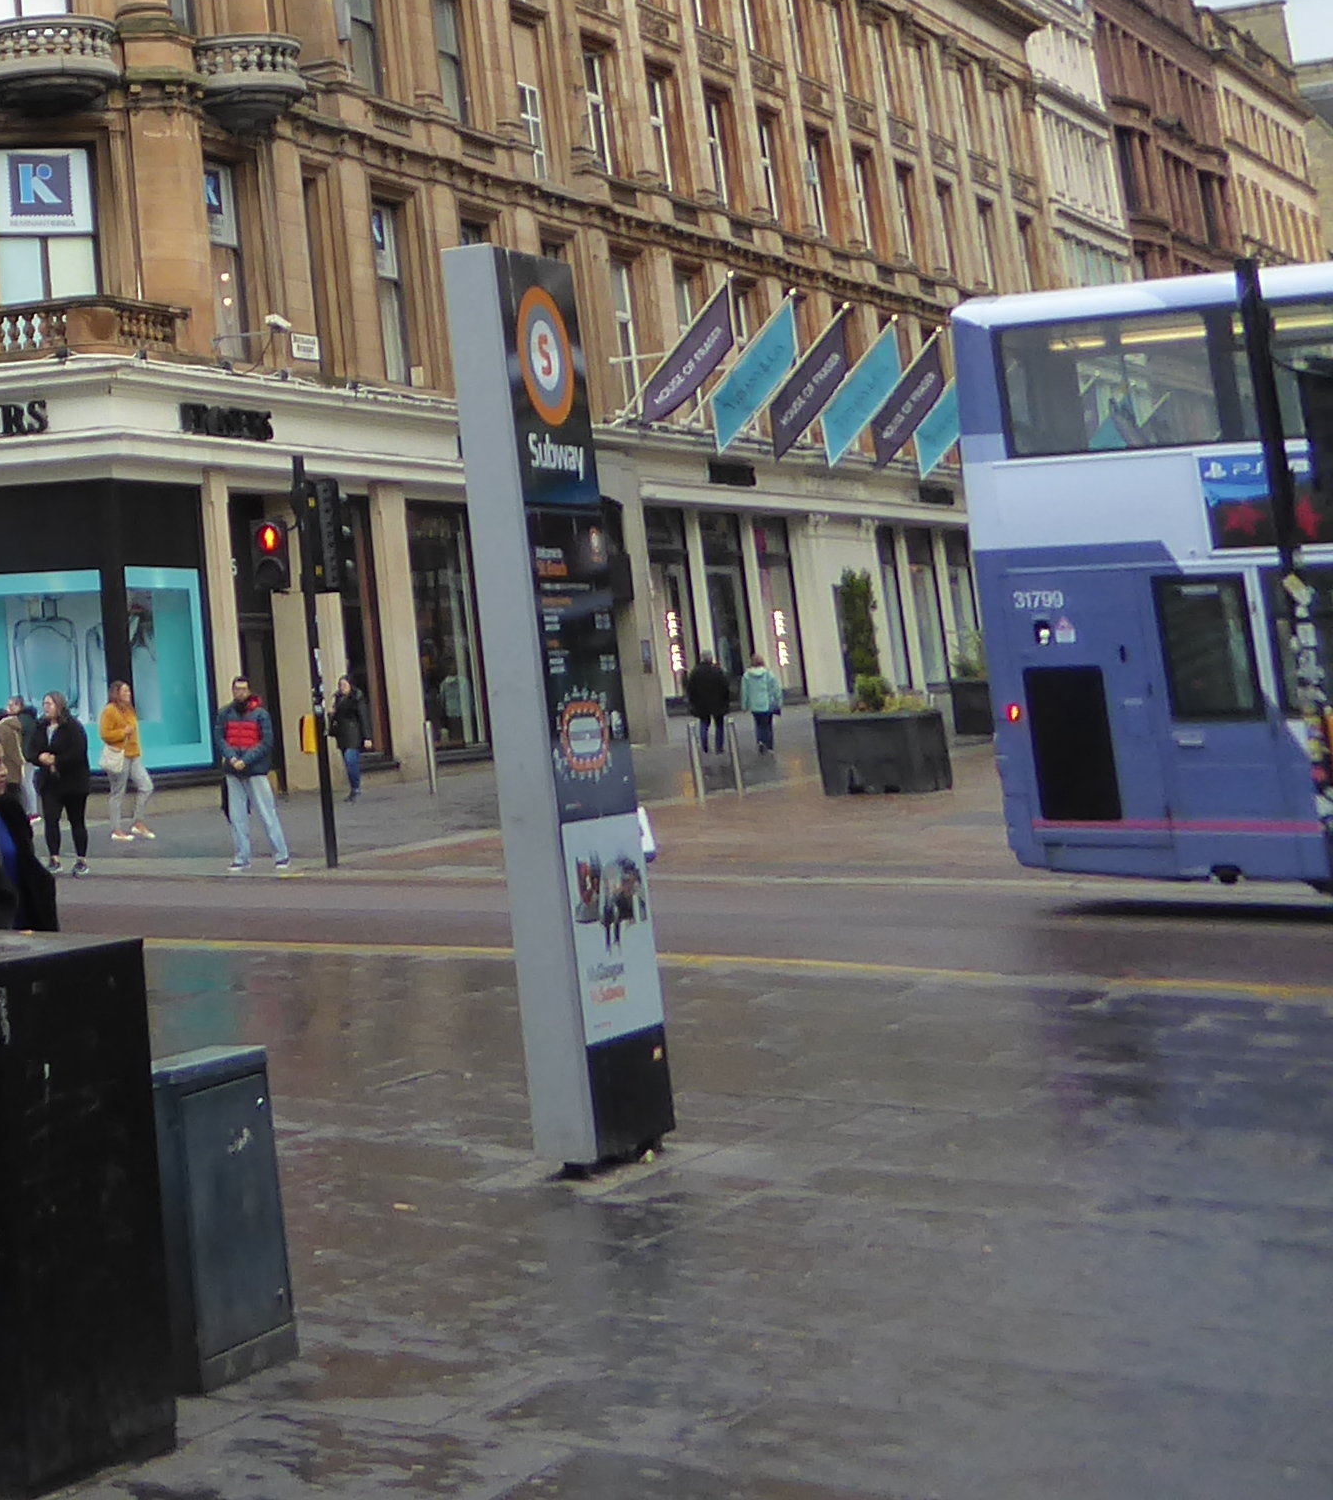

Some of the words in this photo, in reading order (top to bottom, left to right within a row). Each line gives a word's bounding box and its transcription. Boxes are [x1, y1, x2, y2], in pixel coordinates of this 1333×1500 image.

[653, 373, 684, 405] HOUSE
[683, 357, 698, 375] OF
[693, 326, 723, 362] FRASER
[780, 397, 807, 426] HOUSE
[803, 381, 815, 398] OF
[528, 432, 584, 481] Subway
[1013, 590, 1064, 609] 31799
